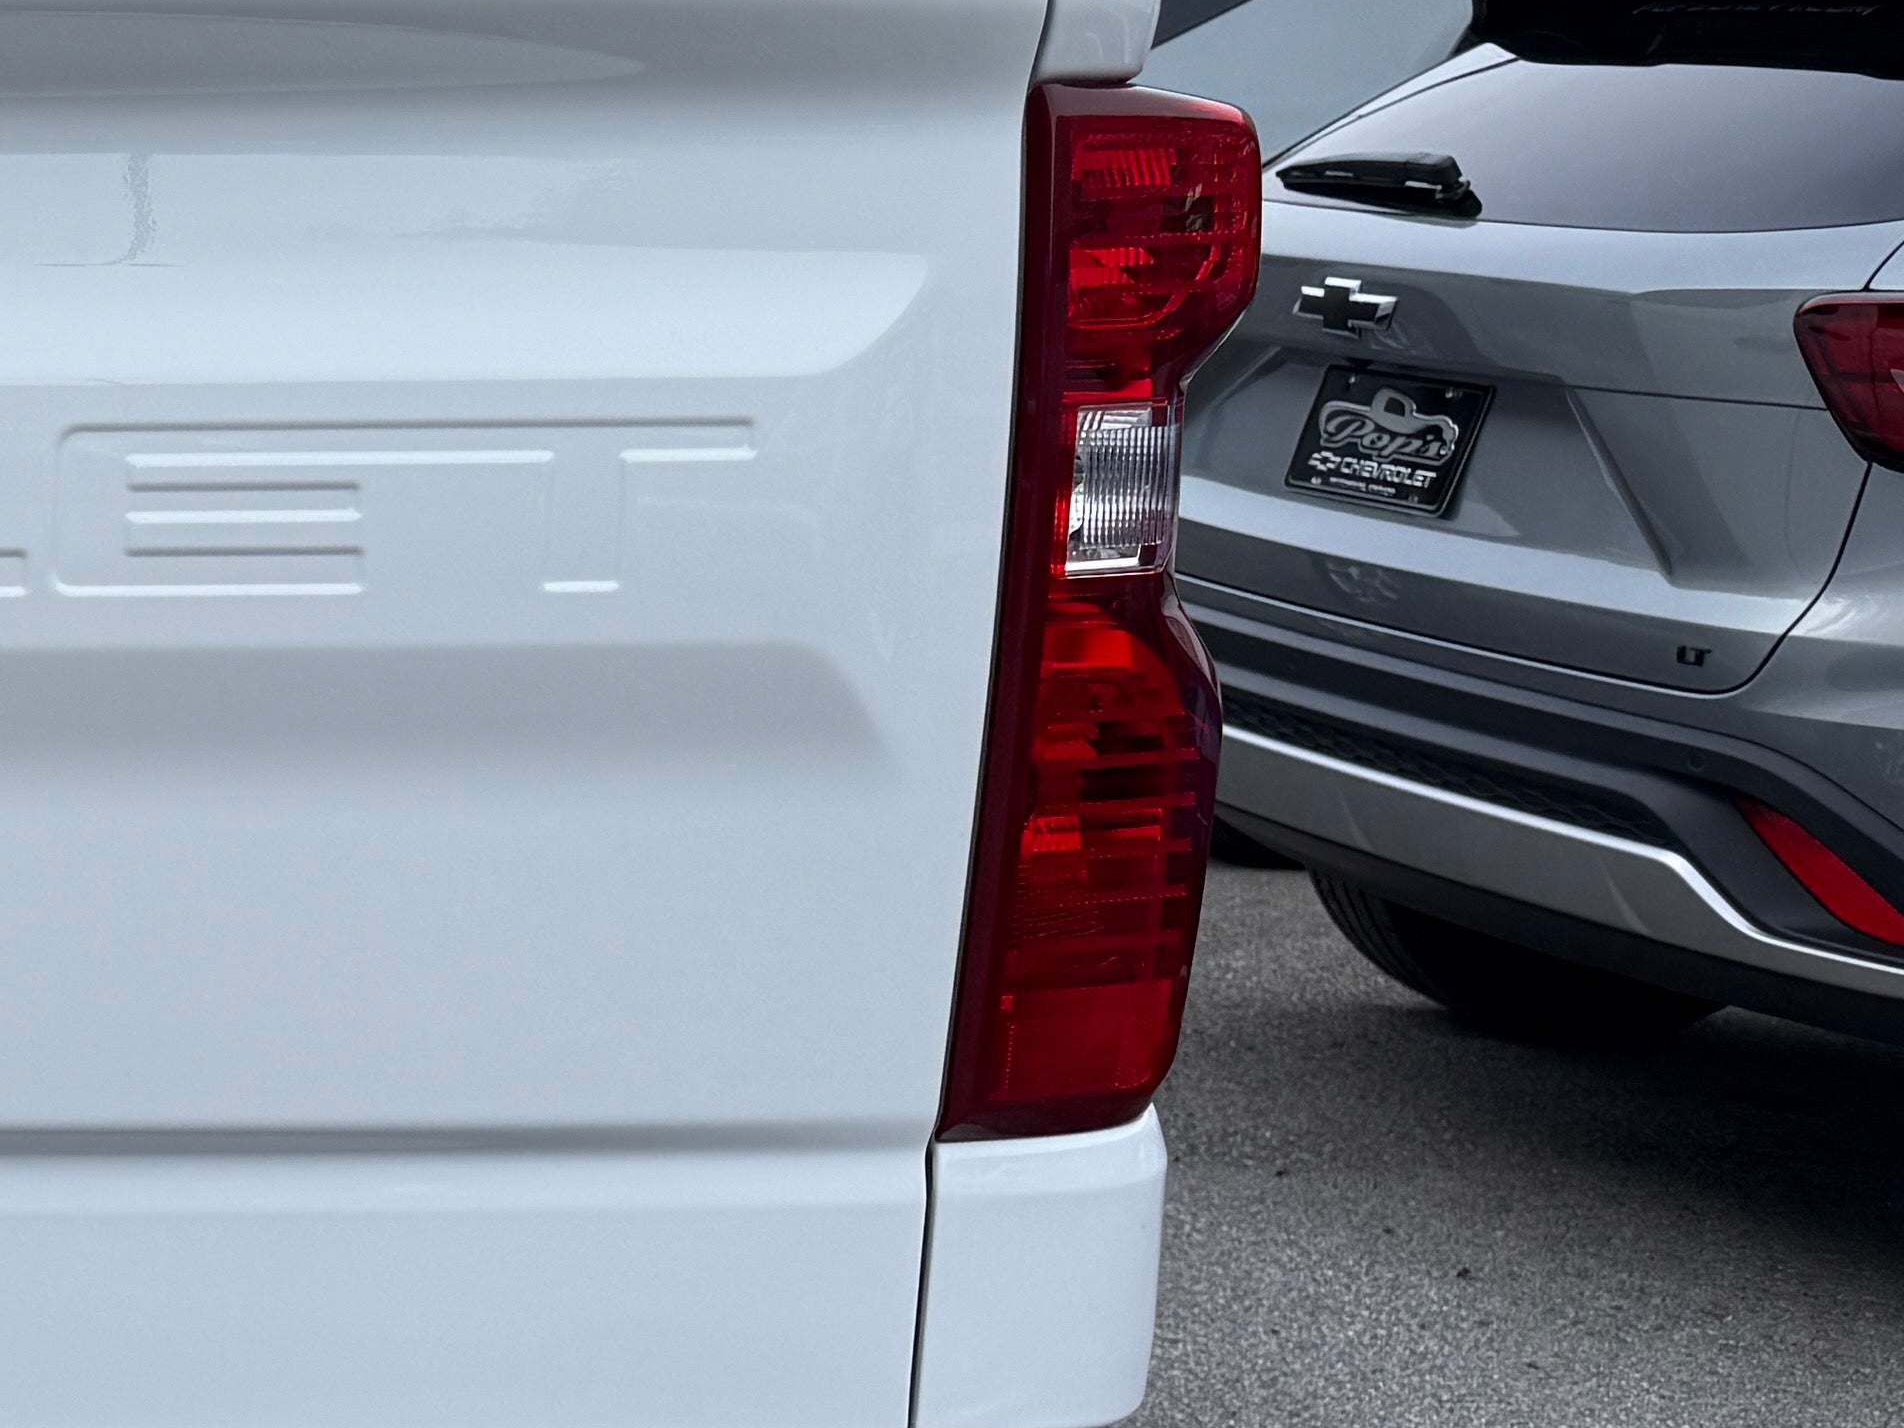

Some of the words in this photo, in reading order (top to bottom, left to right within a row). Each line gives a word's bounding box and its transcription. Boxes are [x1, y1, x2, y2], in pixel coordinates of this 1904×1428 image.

[1326, 415, 1442, 458] Pop's
[1340, 457, 1437, 489] CHEVROLET
[1677, 645, 1712, 667] LT
